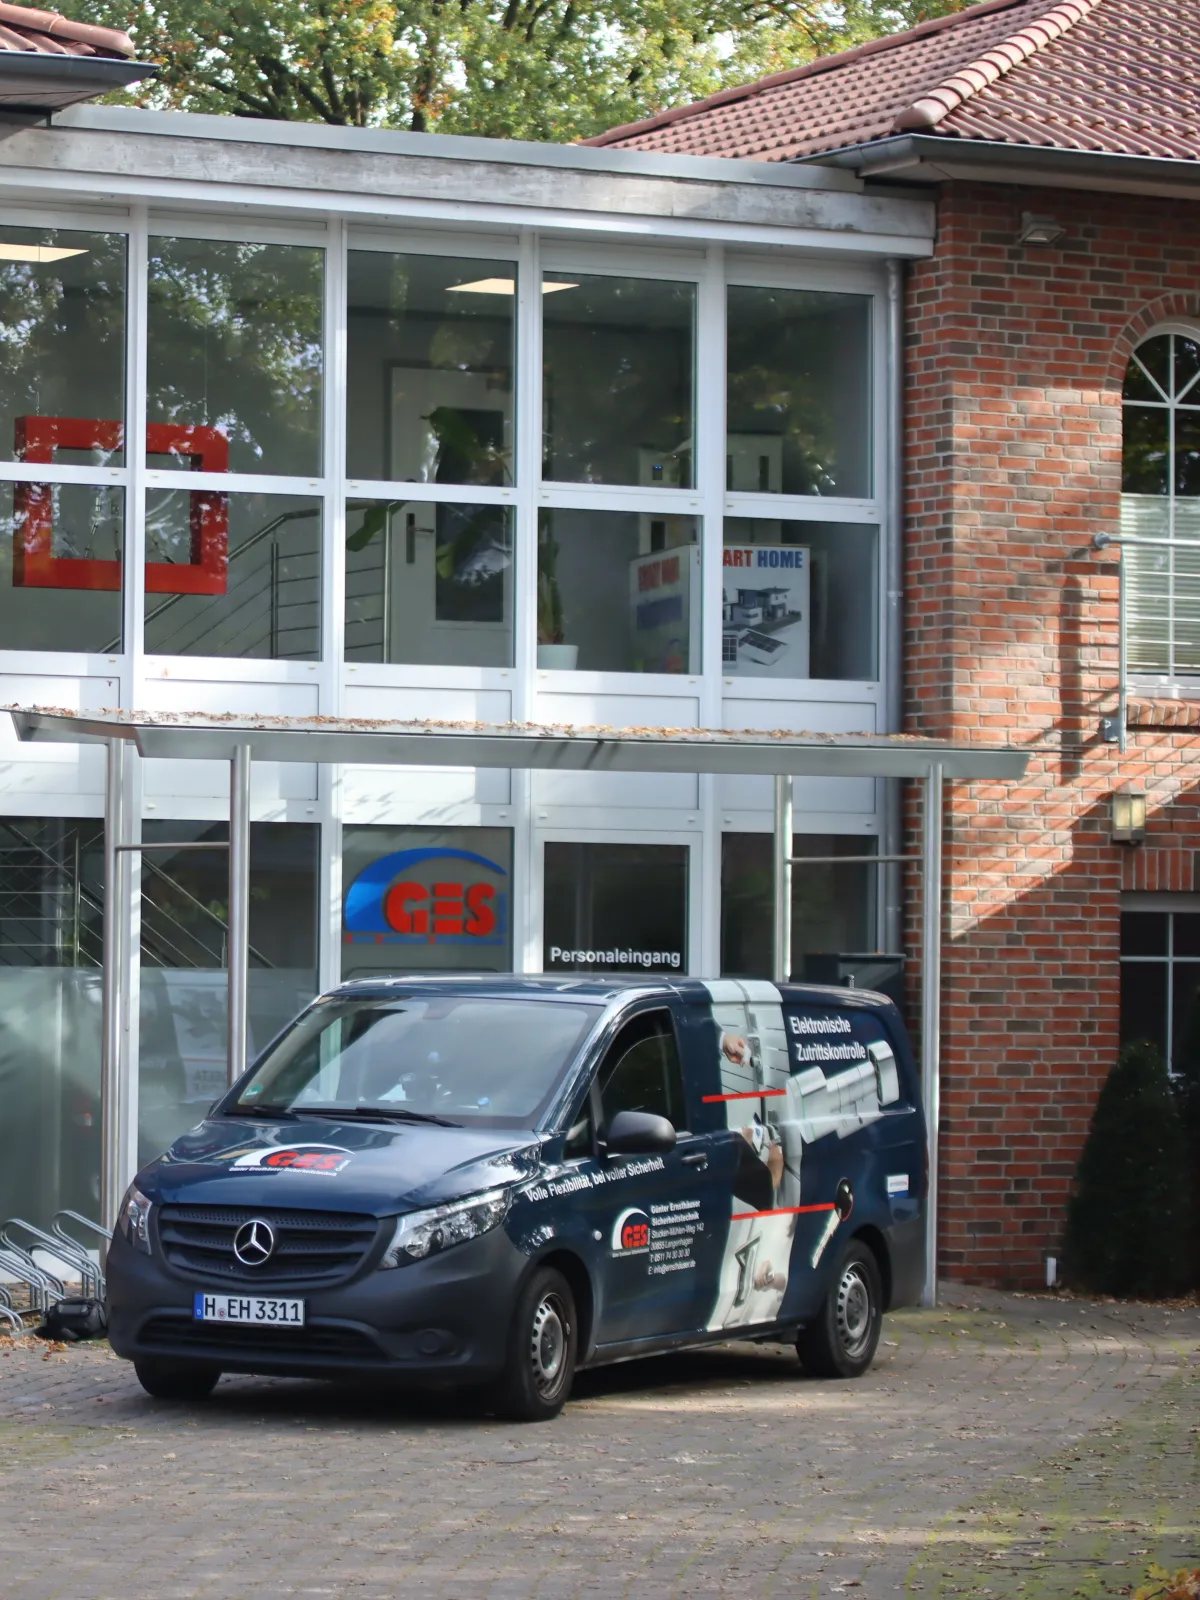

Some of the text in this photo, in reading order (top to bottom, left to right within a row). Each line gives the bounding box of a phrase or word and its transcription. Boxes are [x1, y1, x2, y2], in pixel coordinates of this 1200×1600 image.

[757, 551, 803, 568] HOME
[386, 881, 497, 936] GES
[550, 947, 681, 967] Personaleingang
[789, 1016, 852, 1035] Elektronische
[795, 1041, 867, 1061] Zutrittskontrolle
[267, 1151, 344, 1171] GES
[525, 1156, 666, 1203] Volle Flexibilität, bei voller Sicherheit
[623, 1223, 648, 1249] GES
[205, 1297, 301, 1322] H EH 3311
